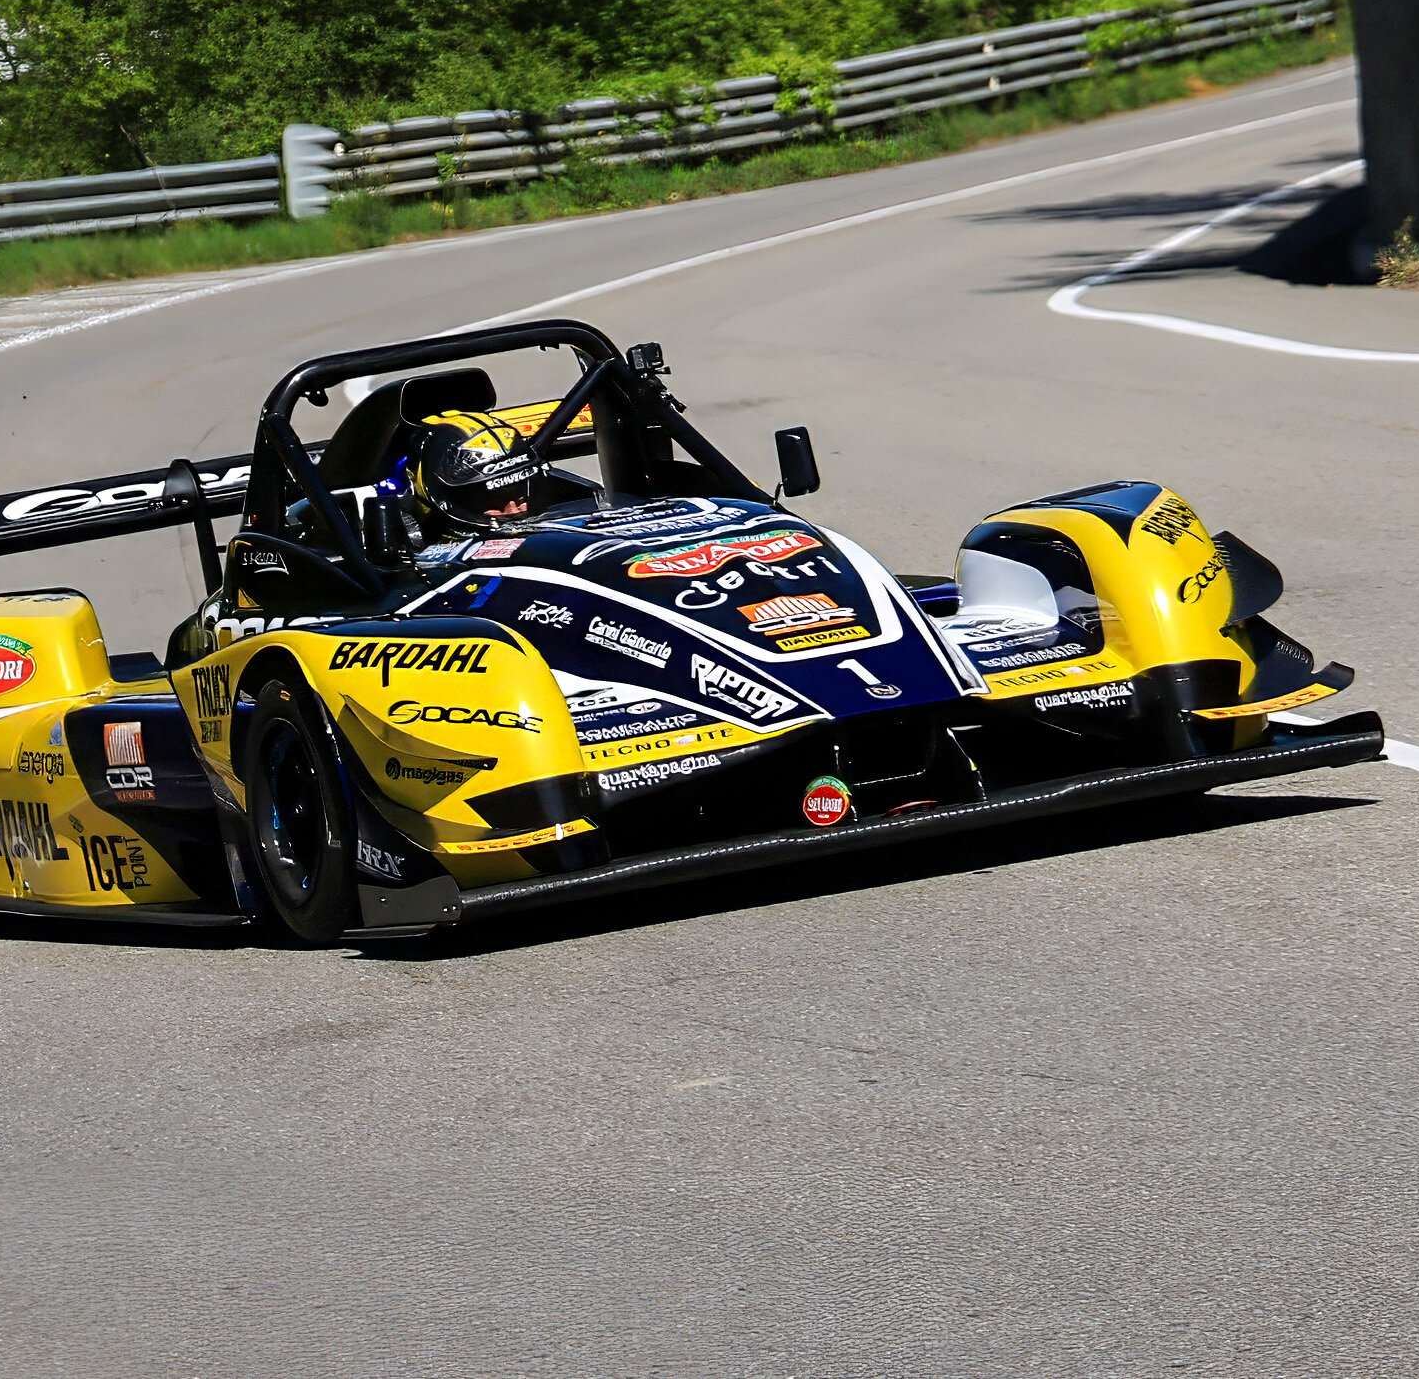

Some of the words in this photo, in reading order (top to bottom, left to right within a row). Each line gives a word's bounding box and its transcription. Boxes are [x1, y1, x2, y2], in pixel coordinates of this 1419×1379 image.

[646, 535, 802, 573] SALVADORI
[328, 641, 491, 688] BARDAHL
[836, 658, 882, 685] 1
[691, 653, 799, 720] RAPTOR
[388, 700, 543, 734] SOCAGE
[106, 767, 155, 789] CDR
[79, 834, 135, 891] ICE
[124, 837, 152, 887] POINT
